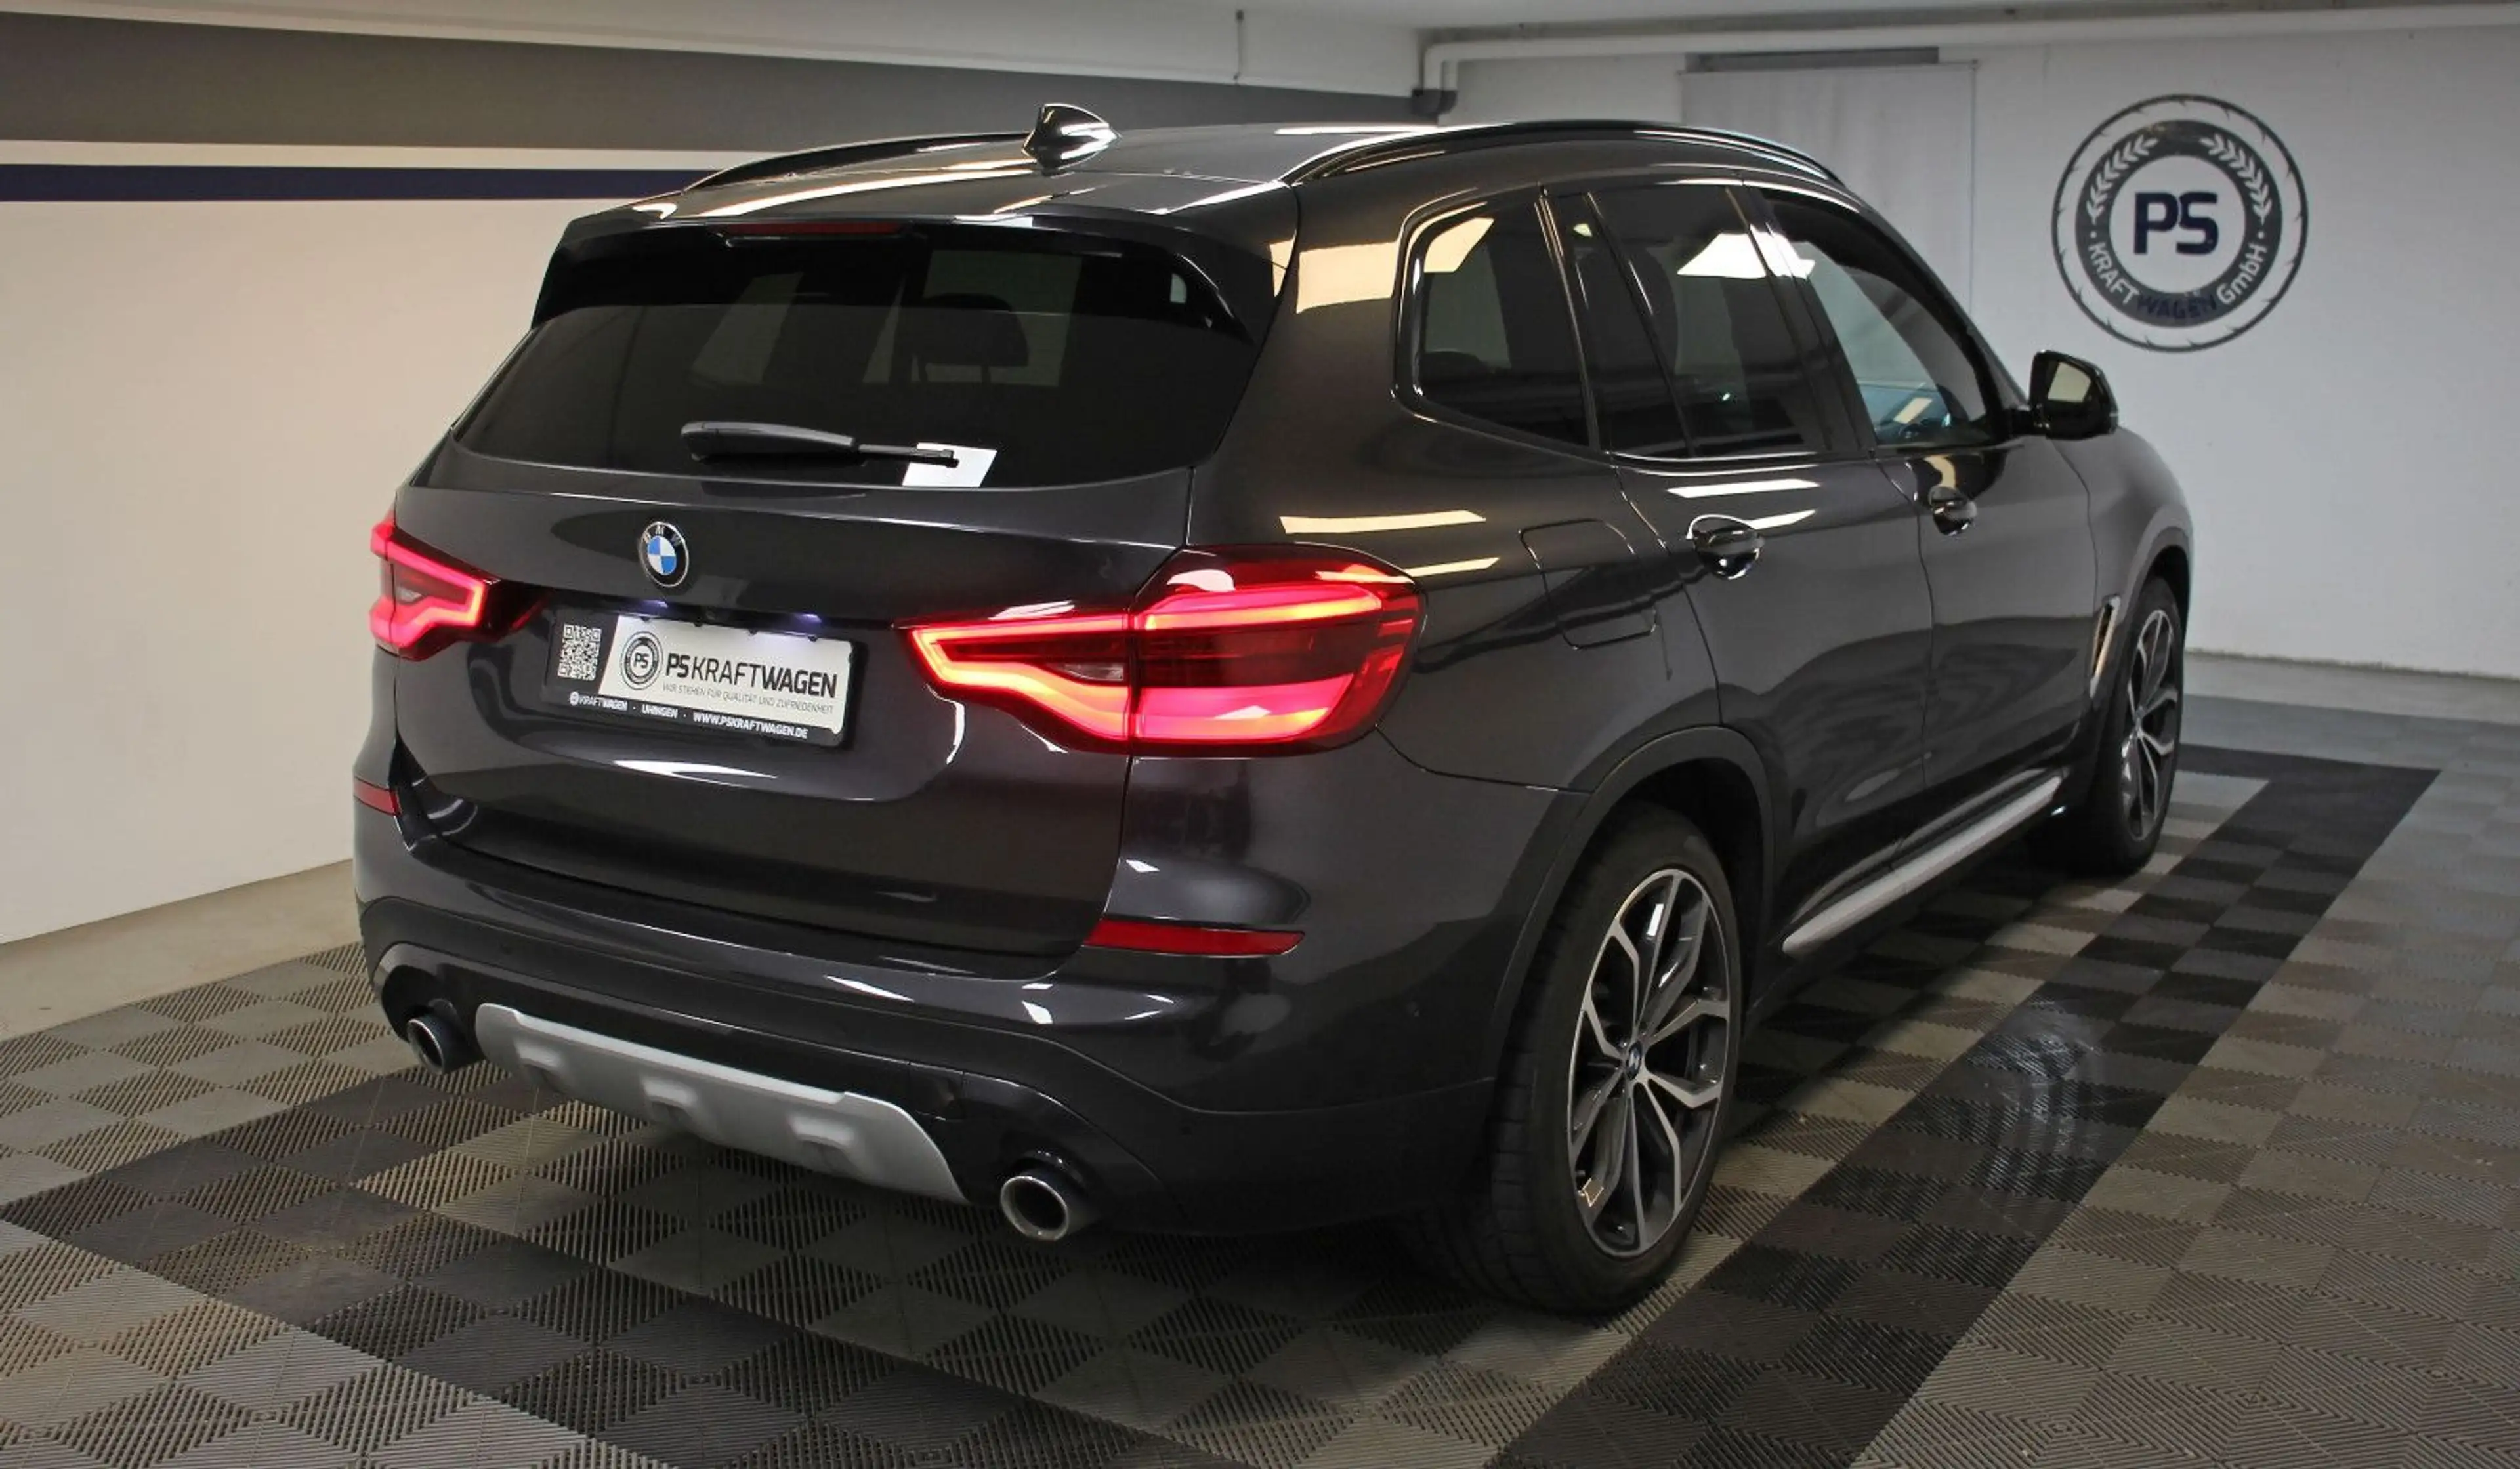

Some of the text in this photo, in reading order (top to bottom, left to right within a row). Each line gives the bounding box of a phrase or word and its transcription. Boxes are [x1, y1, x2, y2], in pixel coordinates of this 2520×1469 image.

[2133, 190, 2219, 255] PS
[2216, 242, 2268, 305] GmbH
[633, 652, 650, 668] PS
[692, 711, 809, 739] WWW.PSKRAFTWAGEN.DE
